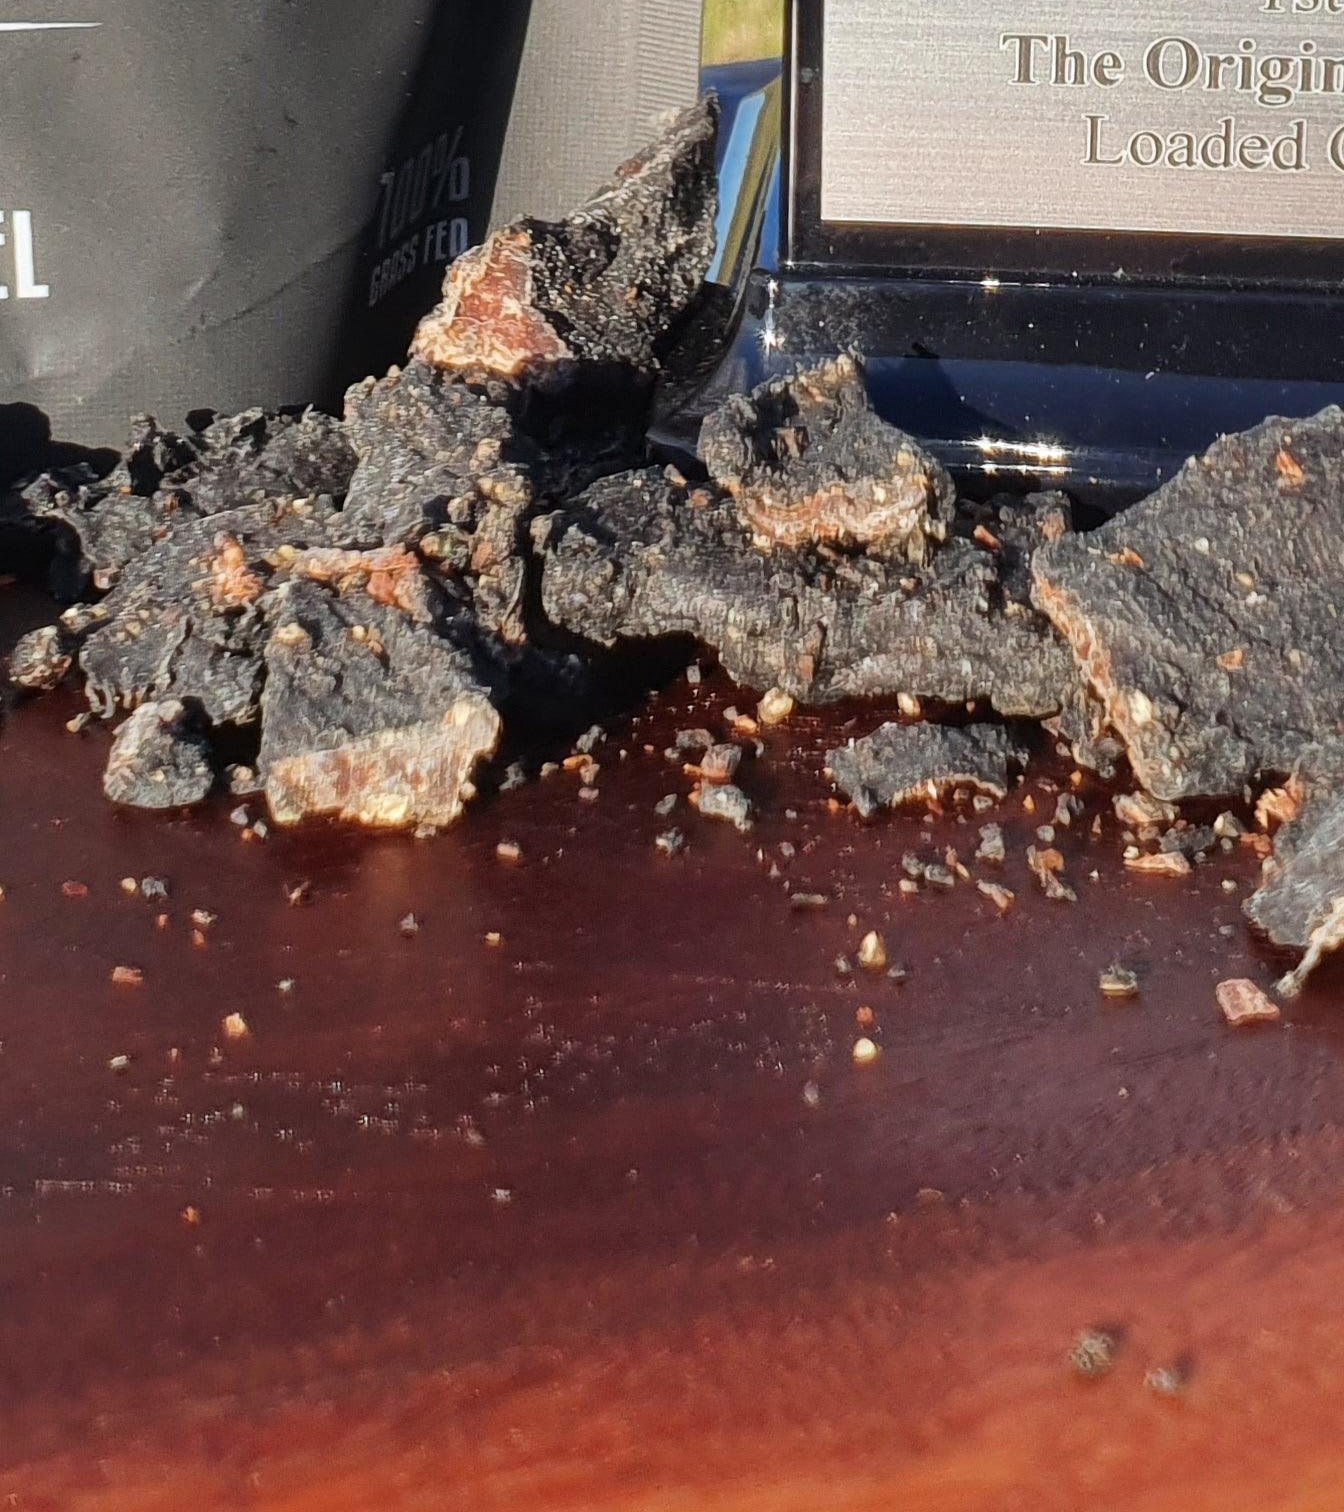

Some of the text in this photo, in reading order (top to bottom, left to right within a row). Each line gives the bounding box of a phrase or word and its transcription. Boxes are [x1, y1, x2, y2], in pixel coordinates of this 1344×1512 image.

[1000, 33, 1124, 88] The
[1083, 115, 1306, 174] Loaded
[422, 216, 469, 265] FED
